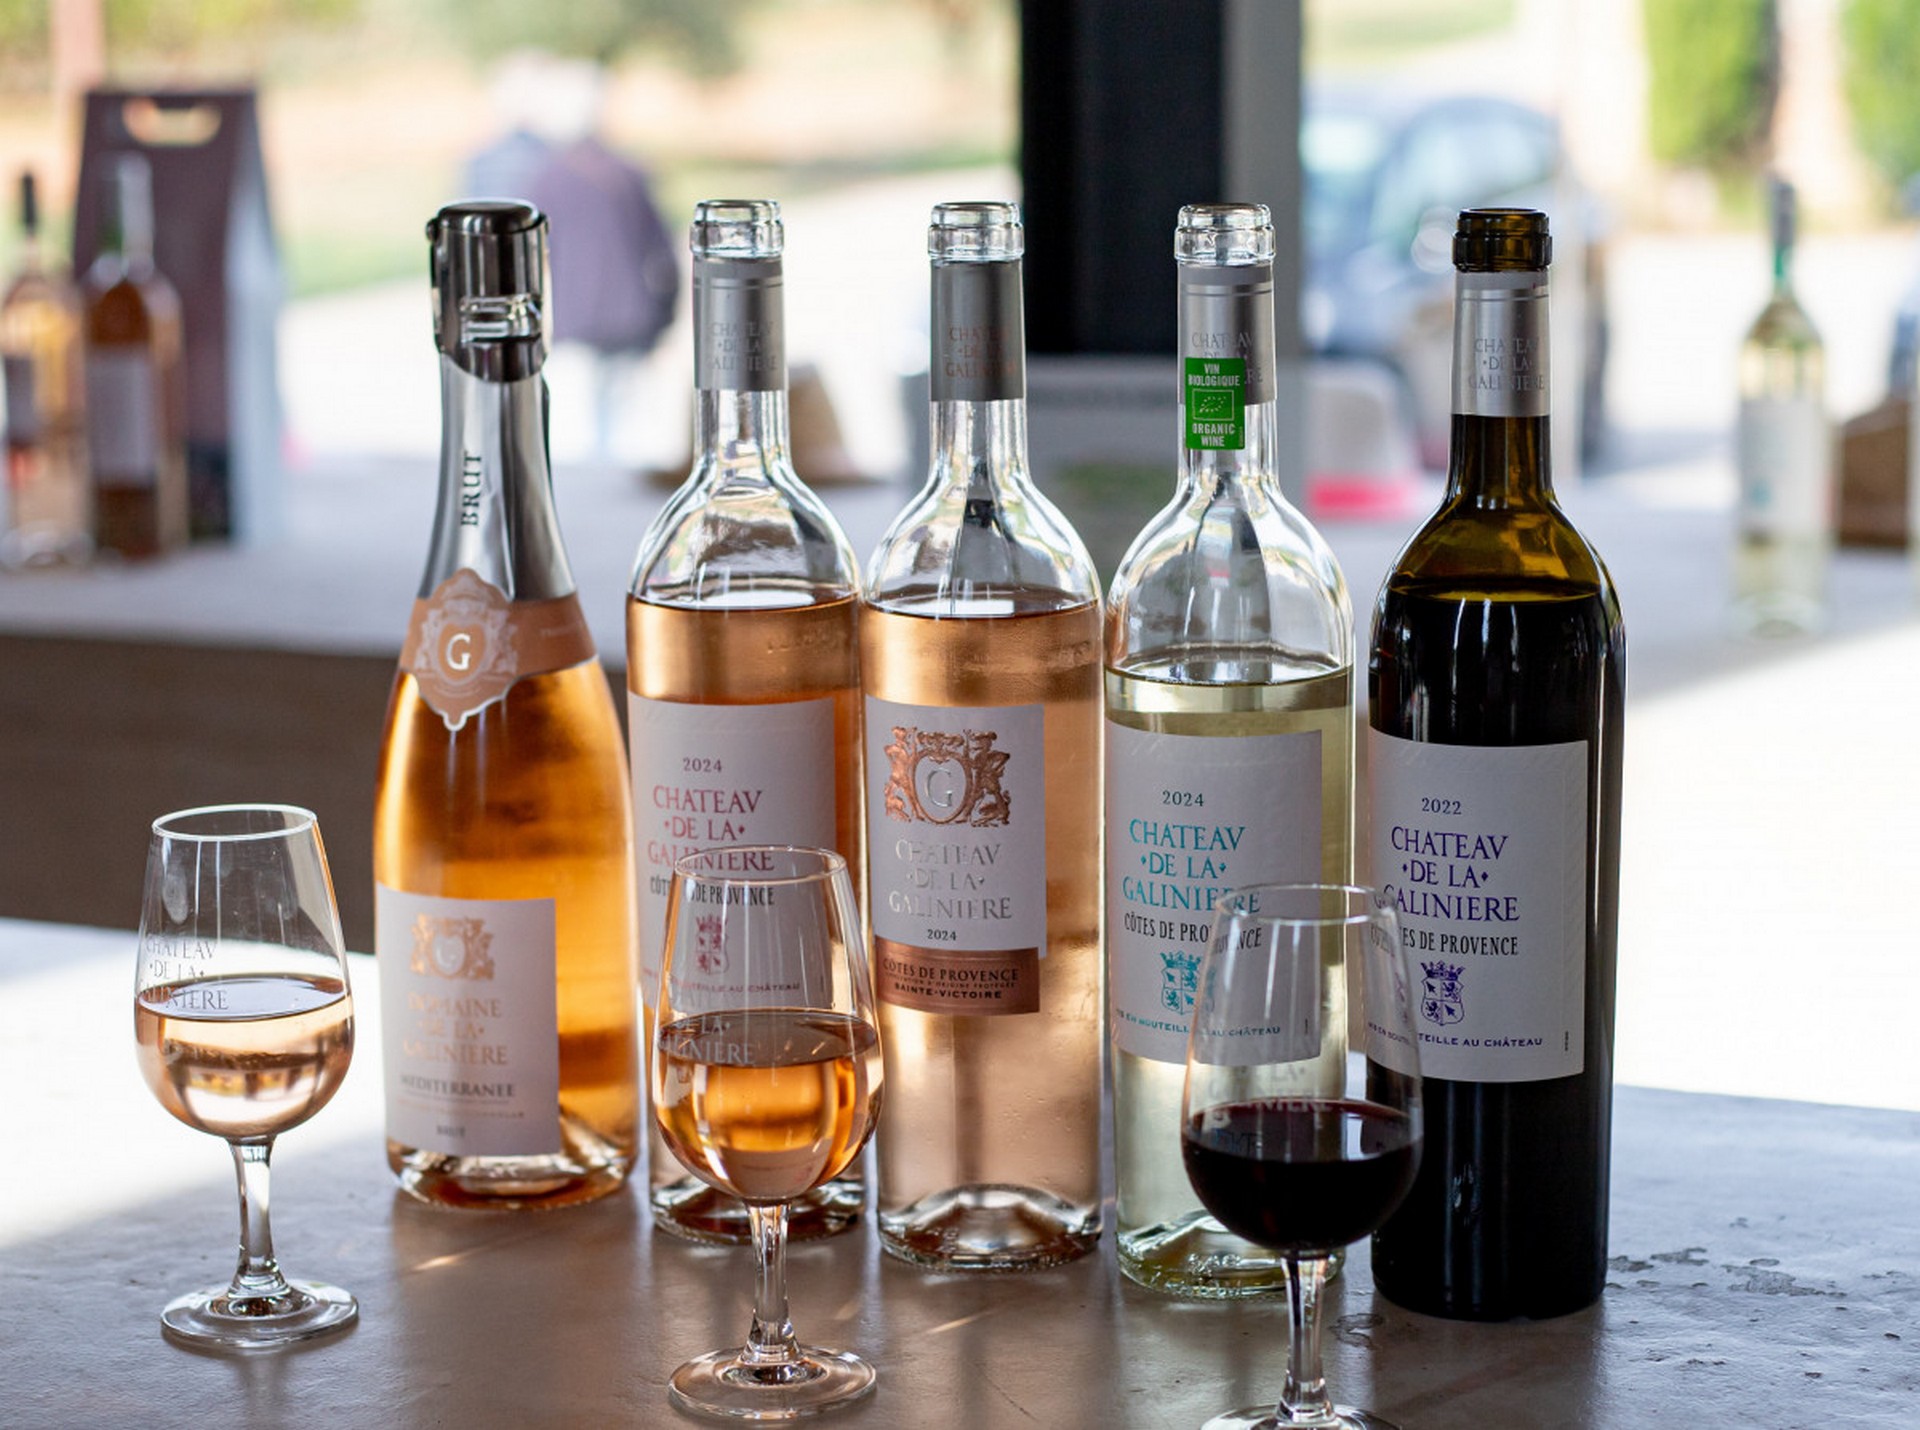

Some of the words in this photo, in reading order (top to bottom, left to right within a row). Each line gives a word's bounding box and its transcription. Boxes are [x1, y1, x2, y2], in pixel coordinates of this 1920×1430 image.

[1203, 363, 1221, 374] VIN
[1188, 374, 1240, 387] BIOLOGIQUE
[1192, 423, 1235, 434] ORGANIC
[1201, 436, 1225, 447] WINE
[461, 451, 482, 526] BRUT
[446, 633, 471, 671] G
[683, 757, 722, 772] 2024
[925, 767, 953, 808] G
[1162, 790, 1204, 807] 2024
[1421, 797, 1462, 815] 2022
[672, 815, 699, 840] DE
[708, 819, 737, 841] LA
[1149, 852, 1177, 877] DE
[1187, 856, 1218, 879] LA
[1410, 859, 1439, 885] DE
[1448, 864, 1481, 888] LA
[927, 929, 957, 941] 2024
[1159, 921, 1175, 940] DE
[1420, 930, 1436, 951] DE
[1440, 933, 1520, 956] PROVENCE
[919, 966, 936, 980] DE
[940, 968, 1019, 982] PROVENCE
[1228, 1025, 1281, 1037] CHÂTEAU
[1463, 1038, 1480, 1047] AU
[1484, 1036, 1543, 1048] CHÂTEAU
